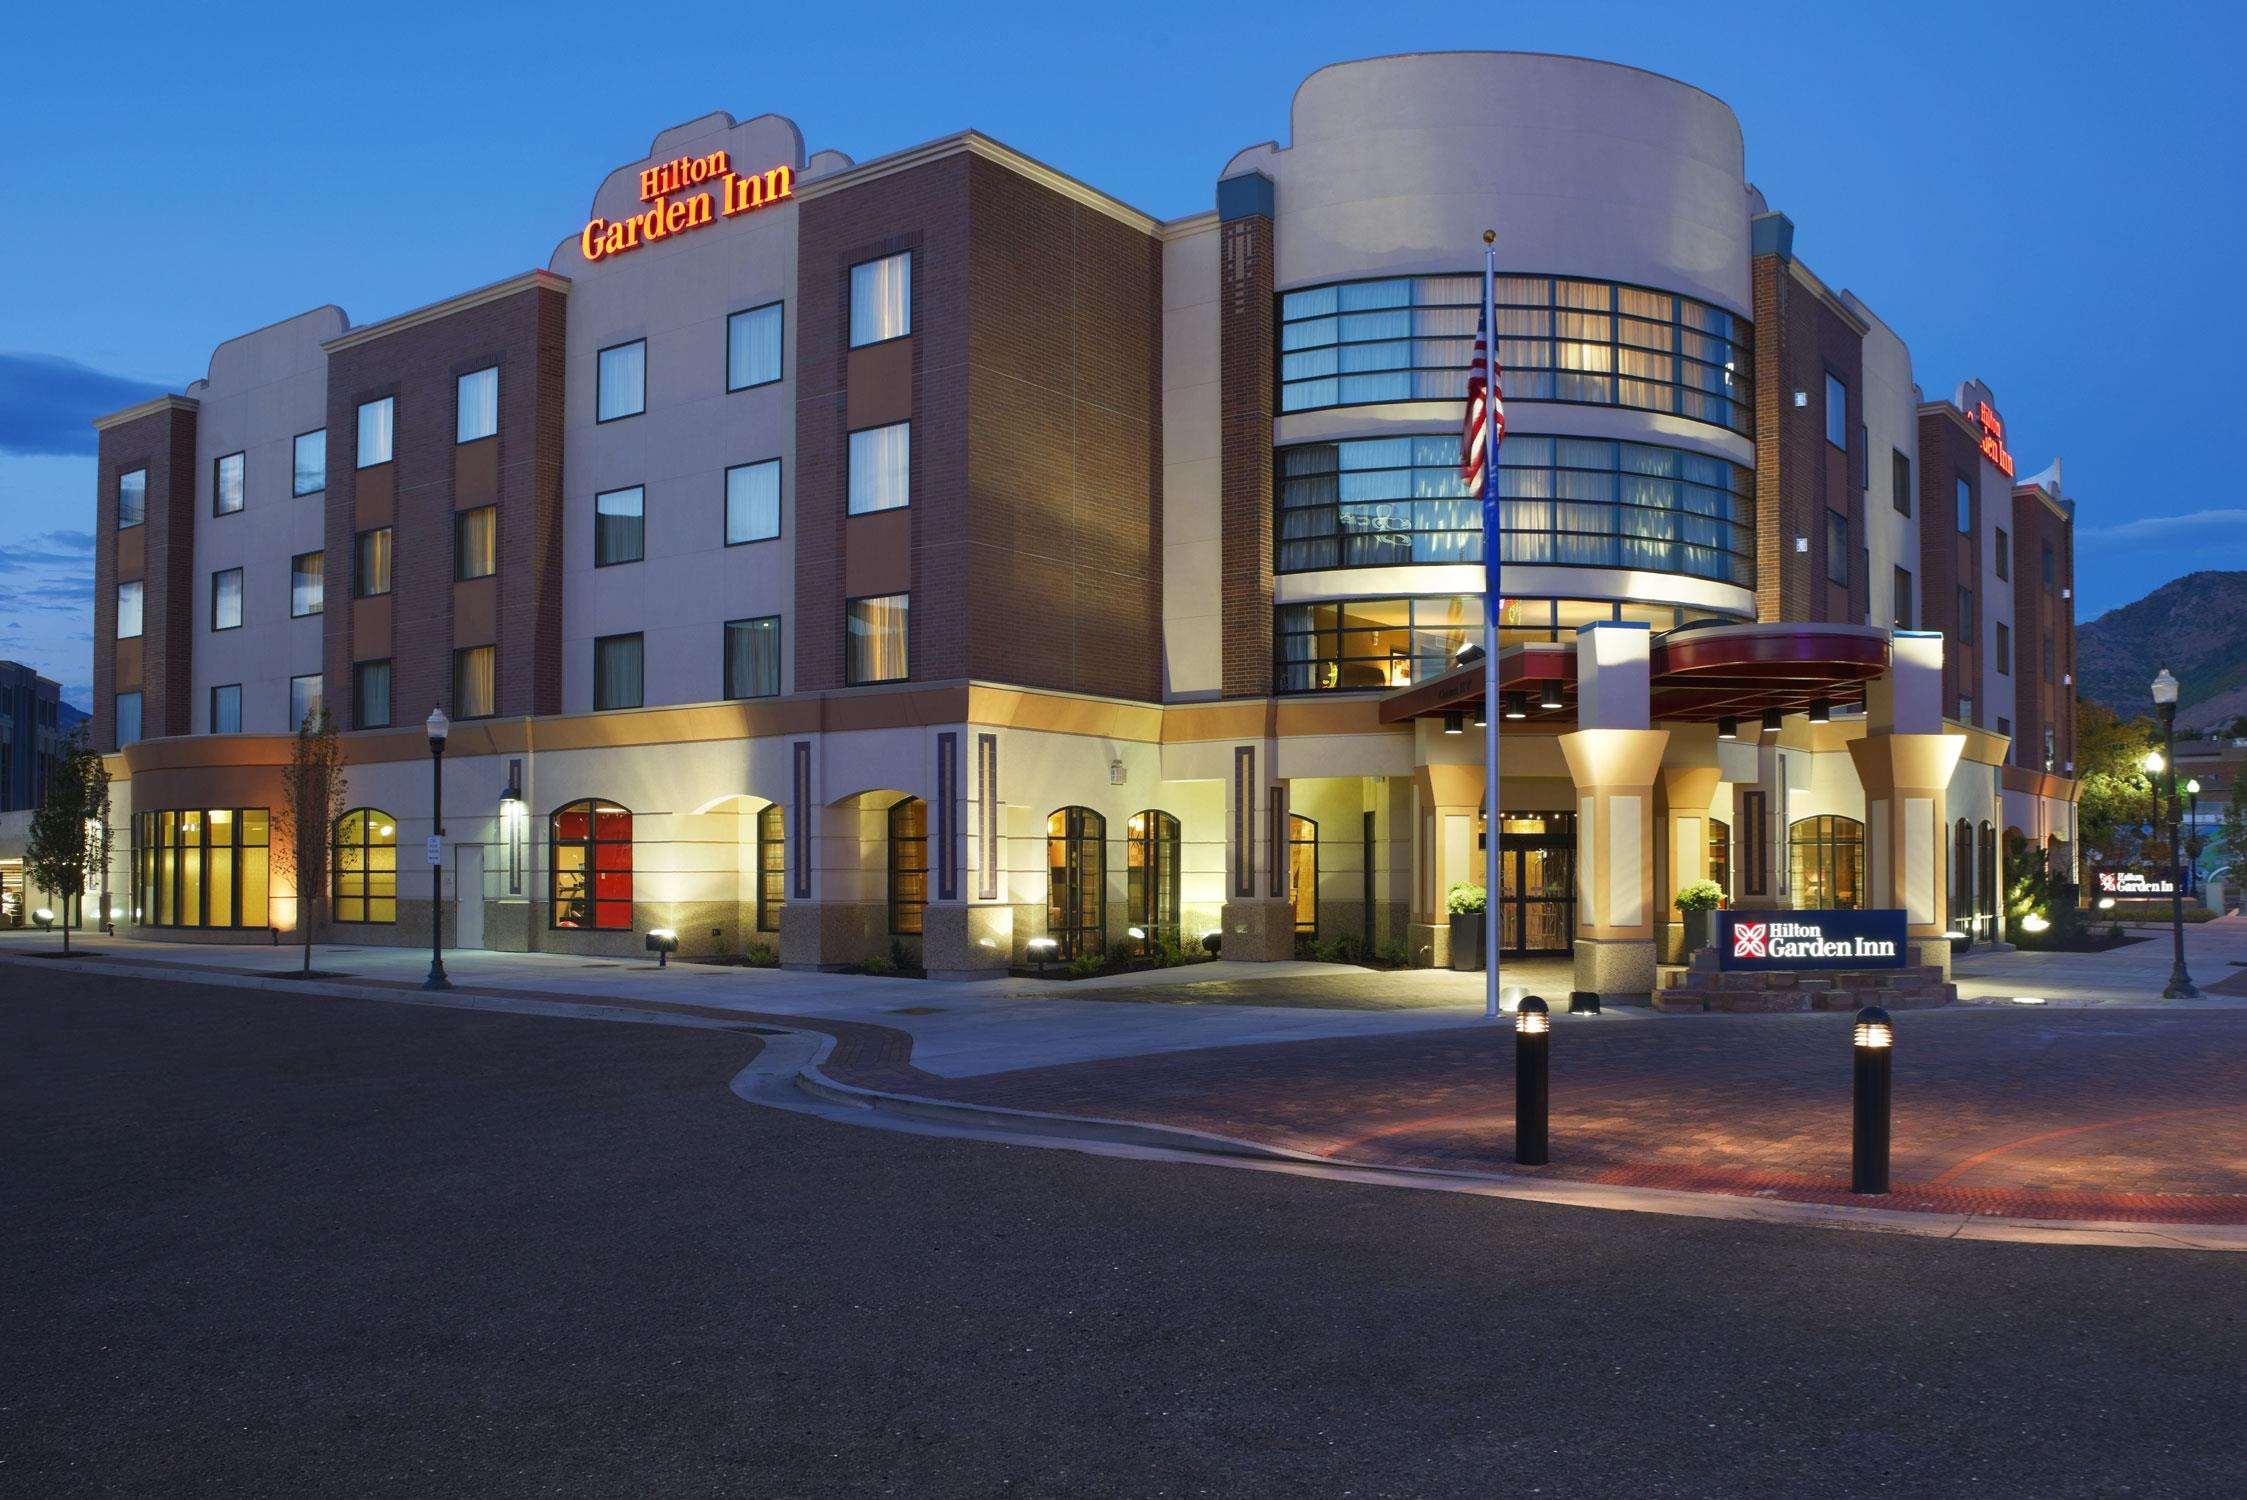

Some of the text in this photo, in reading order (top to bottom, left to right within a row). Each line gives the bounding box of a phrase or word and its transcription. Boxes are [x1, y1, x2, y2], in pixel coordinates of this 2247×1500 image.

[639, 150, 729, 201] Hilton
[581, 164, 793, 261] Garden Inn
[2117, 880, 2160, 892] Garden
[1769, 923, 1821, 938] Hilton
[1768, 937, 1895, 957] Garden Inn
